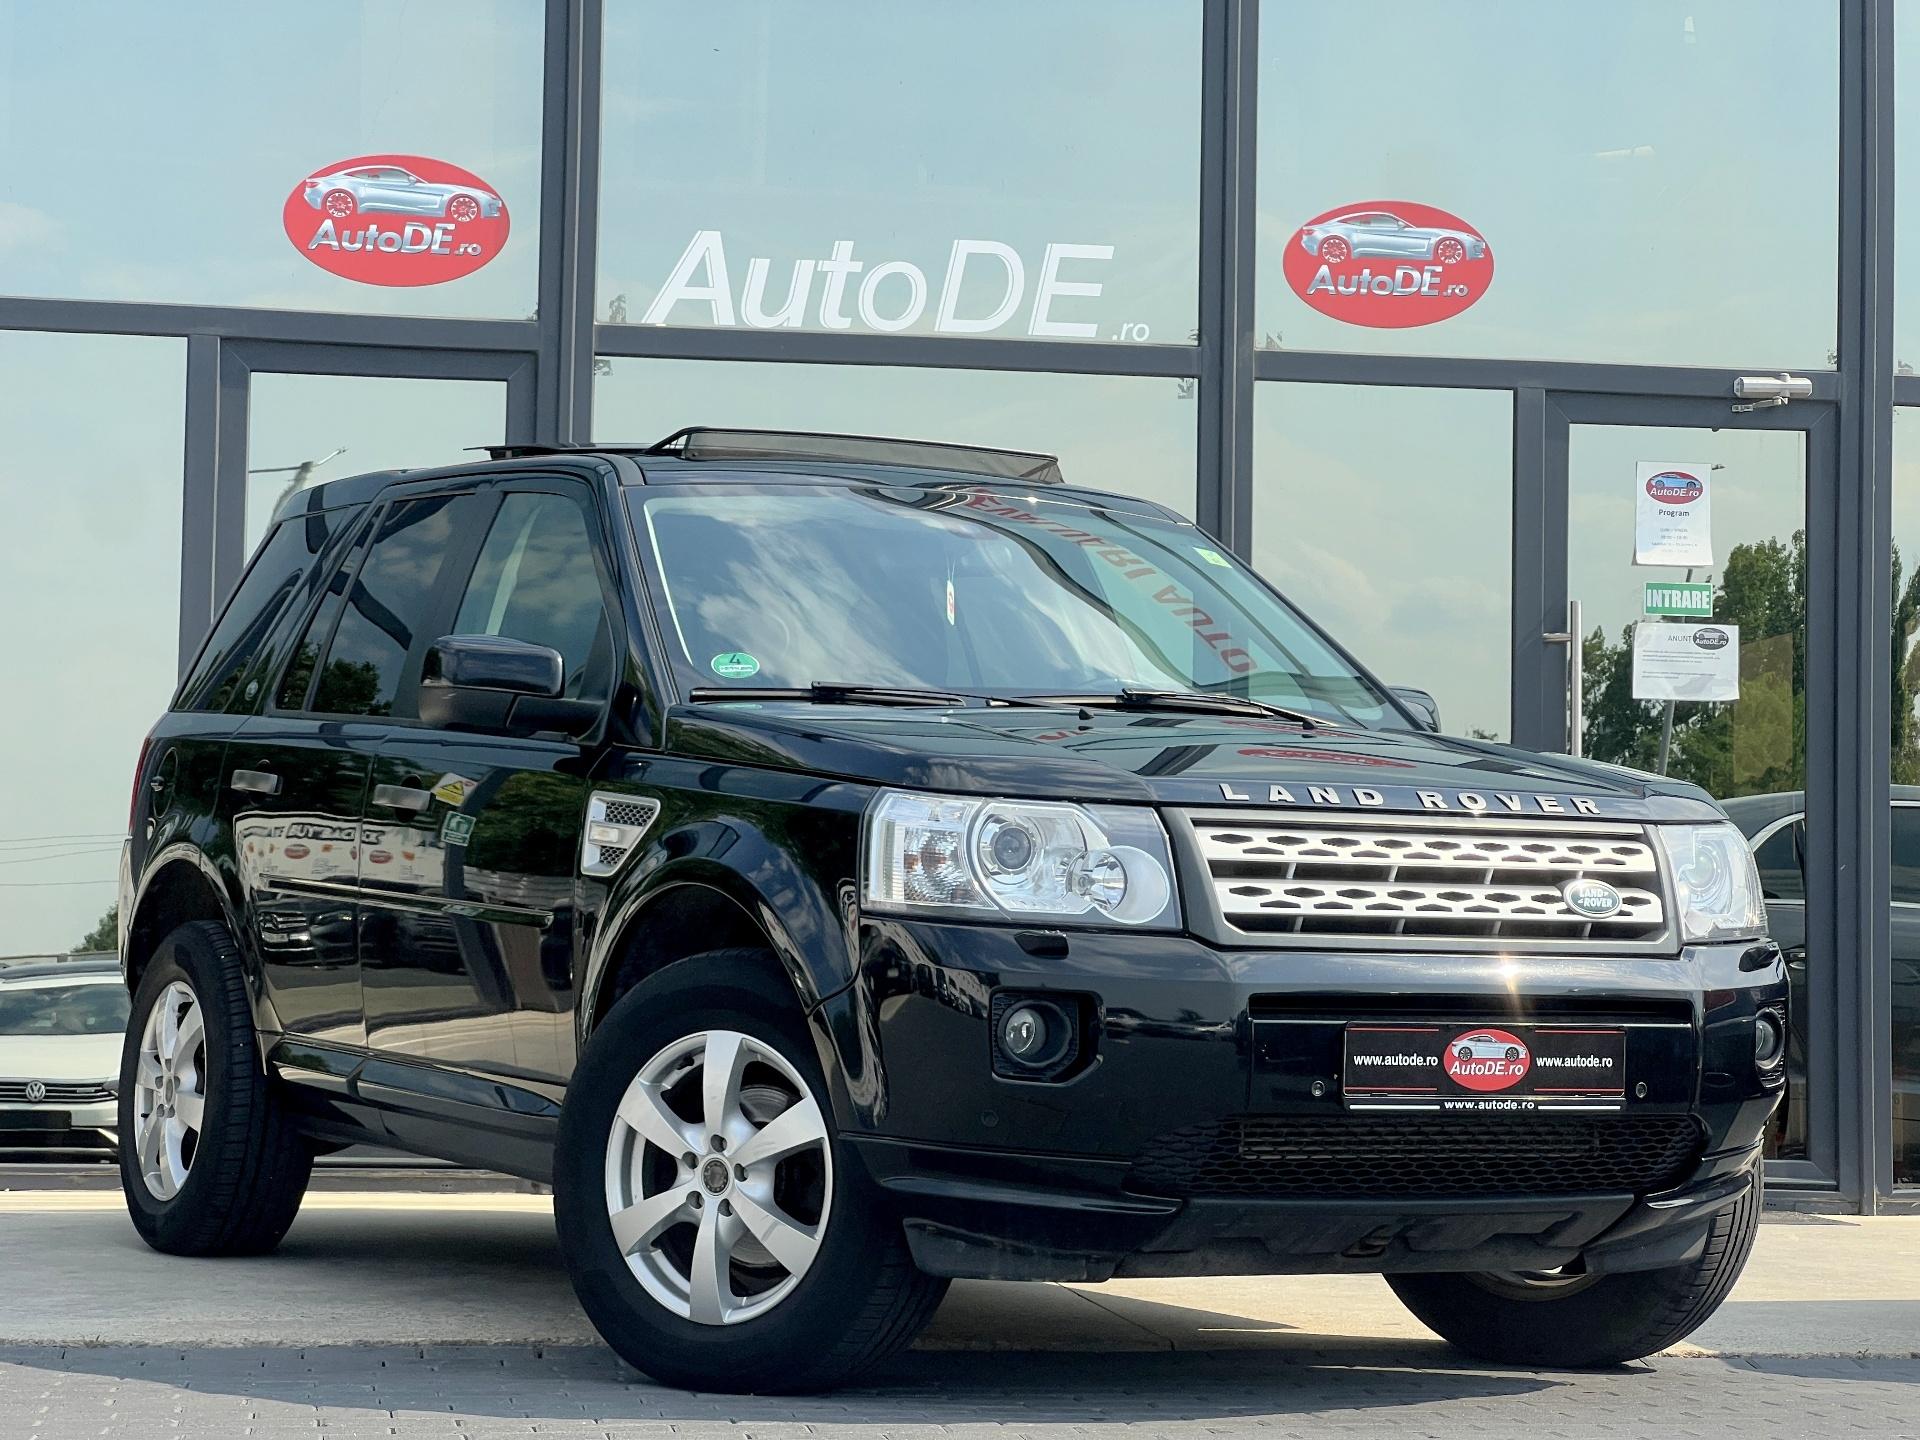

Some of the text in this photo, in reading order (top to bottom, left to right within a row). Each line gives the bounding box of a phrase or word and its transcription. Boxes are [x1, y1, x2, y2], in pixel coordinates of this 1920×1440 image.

[1650, 487, 1700, 497] AutoDE.ro
[1658, 509, 1690, 518] Program
[1646, 589, 1710, 609] INTRARE
[1219, 783, 1601, 815] LAND ROVER
[1579, 888, 1603, 898] LAND
[1583, 897, 1613, 908] ROVER
[1353, 1053, 1439, 1067] www.autode.ro
[1536, 1056, 1613, 1069] www.autode.ro
[1450, 1060, 1524, 1077] AutoDE.ro
[1444, 1099, 1535, 1111] www.autode.ro
